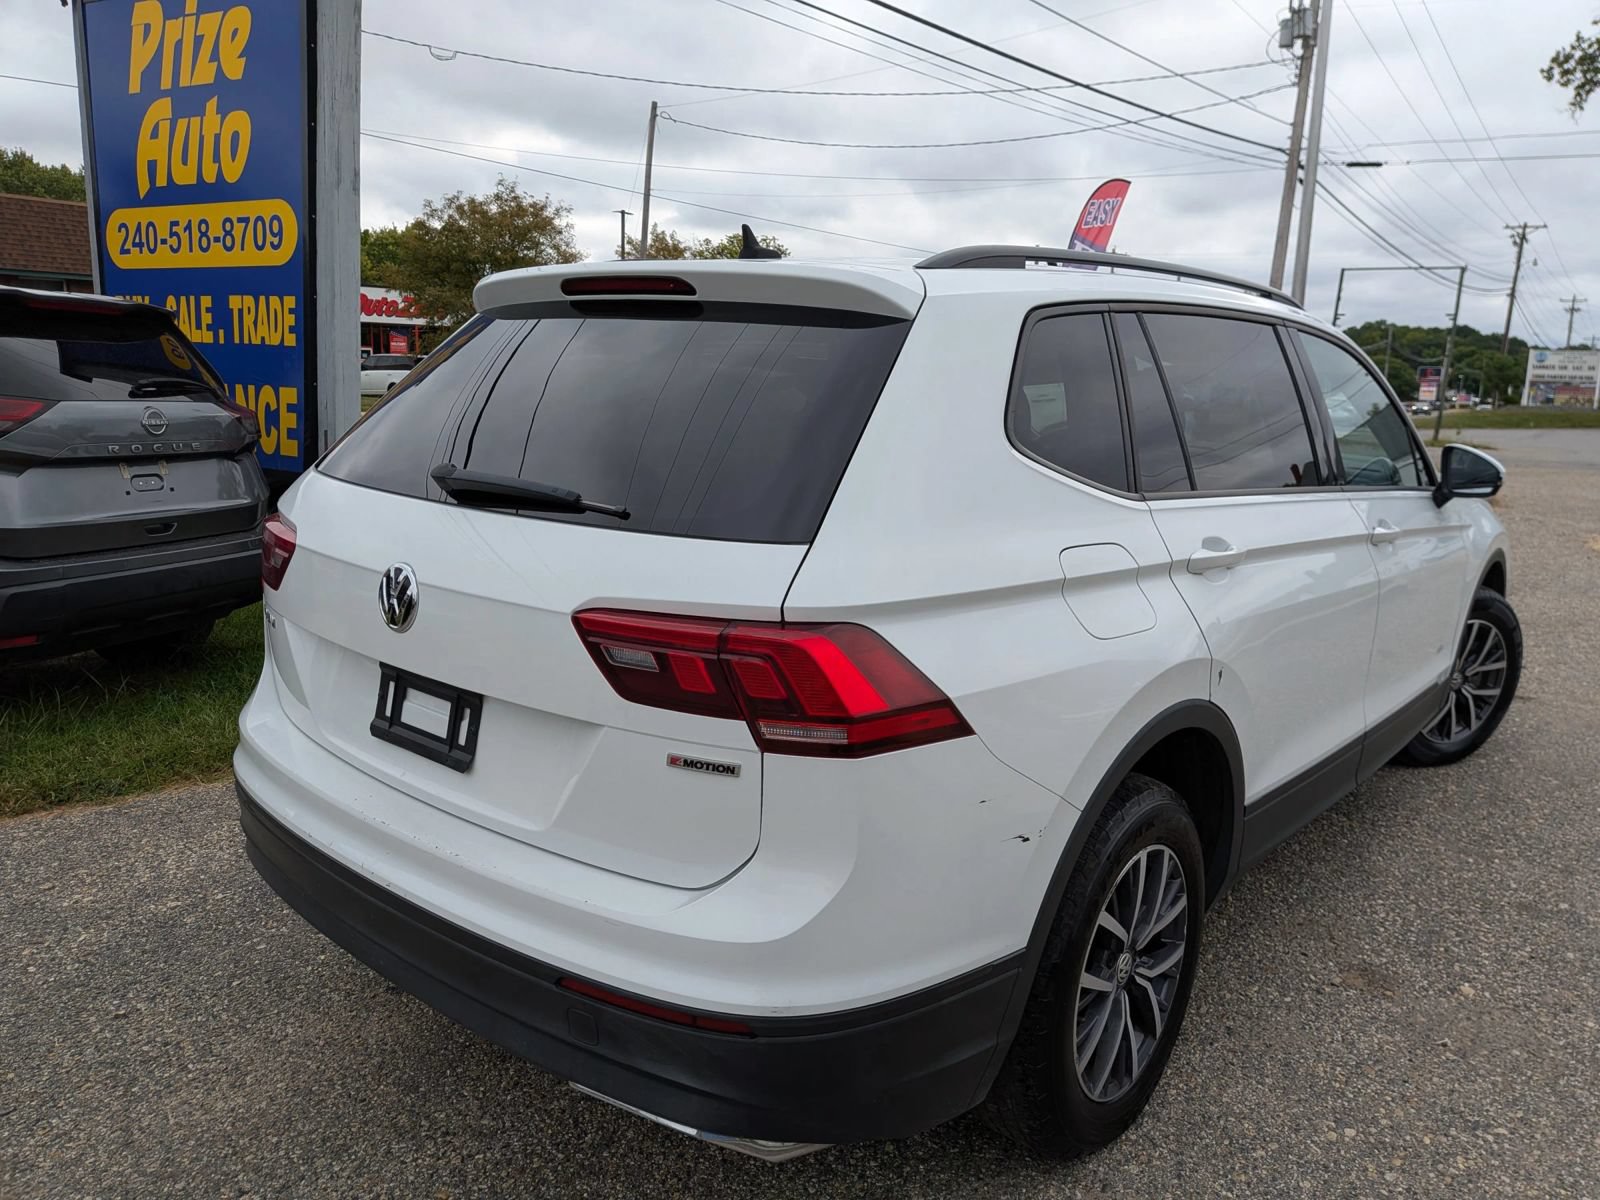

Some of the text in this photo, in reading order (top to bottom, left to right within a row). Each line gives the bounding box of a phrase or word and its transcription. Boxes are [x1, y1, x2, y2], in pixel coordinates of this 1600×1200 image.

[128, 0, 252, 94] Prize
[136, 95, 251, 200] Auto
[117, 215, 283, 256] 240-518-8709
[1081, 197, 1122, 229] EASY
[229, 295, 297, 347] TRADE
[108, 442, 202, 455] ROGUE
